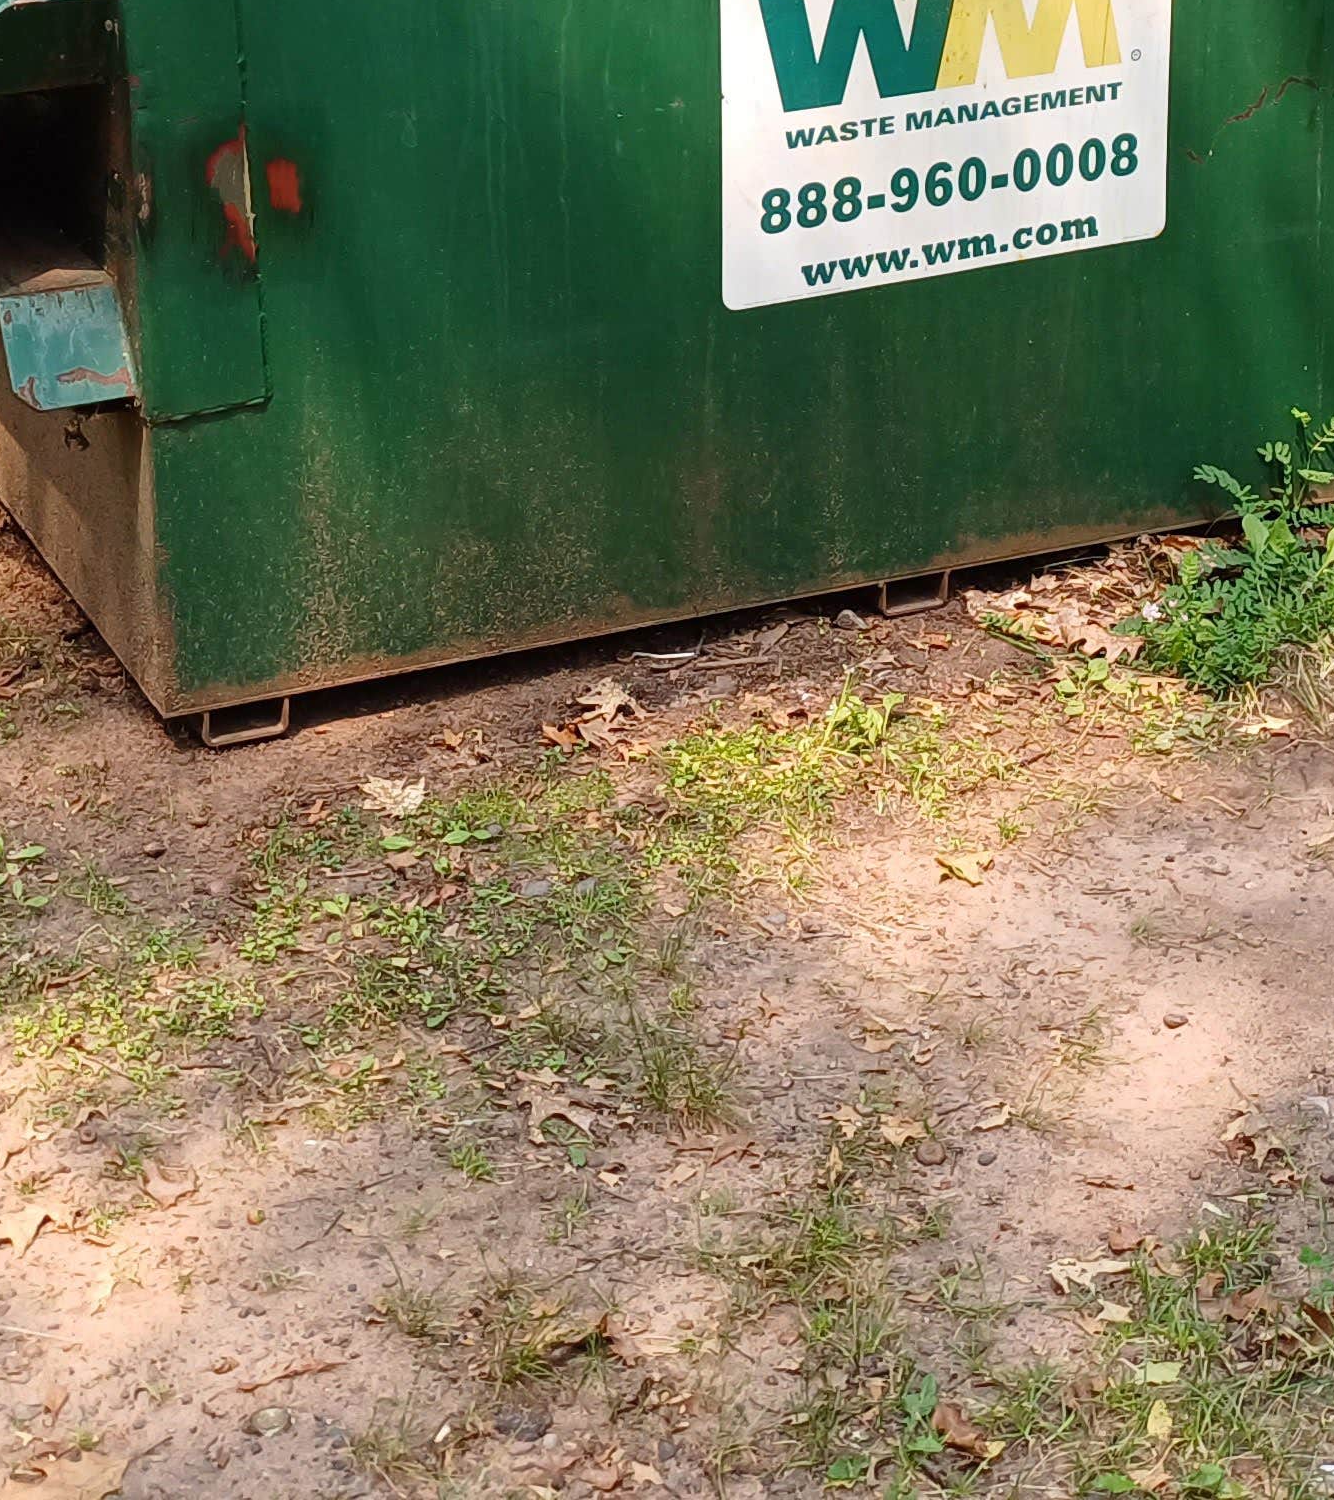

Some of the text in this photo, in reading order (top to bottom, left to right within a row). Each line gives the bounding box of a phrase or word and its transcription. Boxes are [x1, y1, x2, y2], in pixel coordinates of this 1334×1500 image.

[785, 80, 1123, 149] WASTE MANAGEMENT
[760, 132, 1139, 234] 888-960-0008
[801, 213, 1099, 286] www.wm.com
